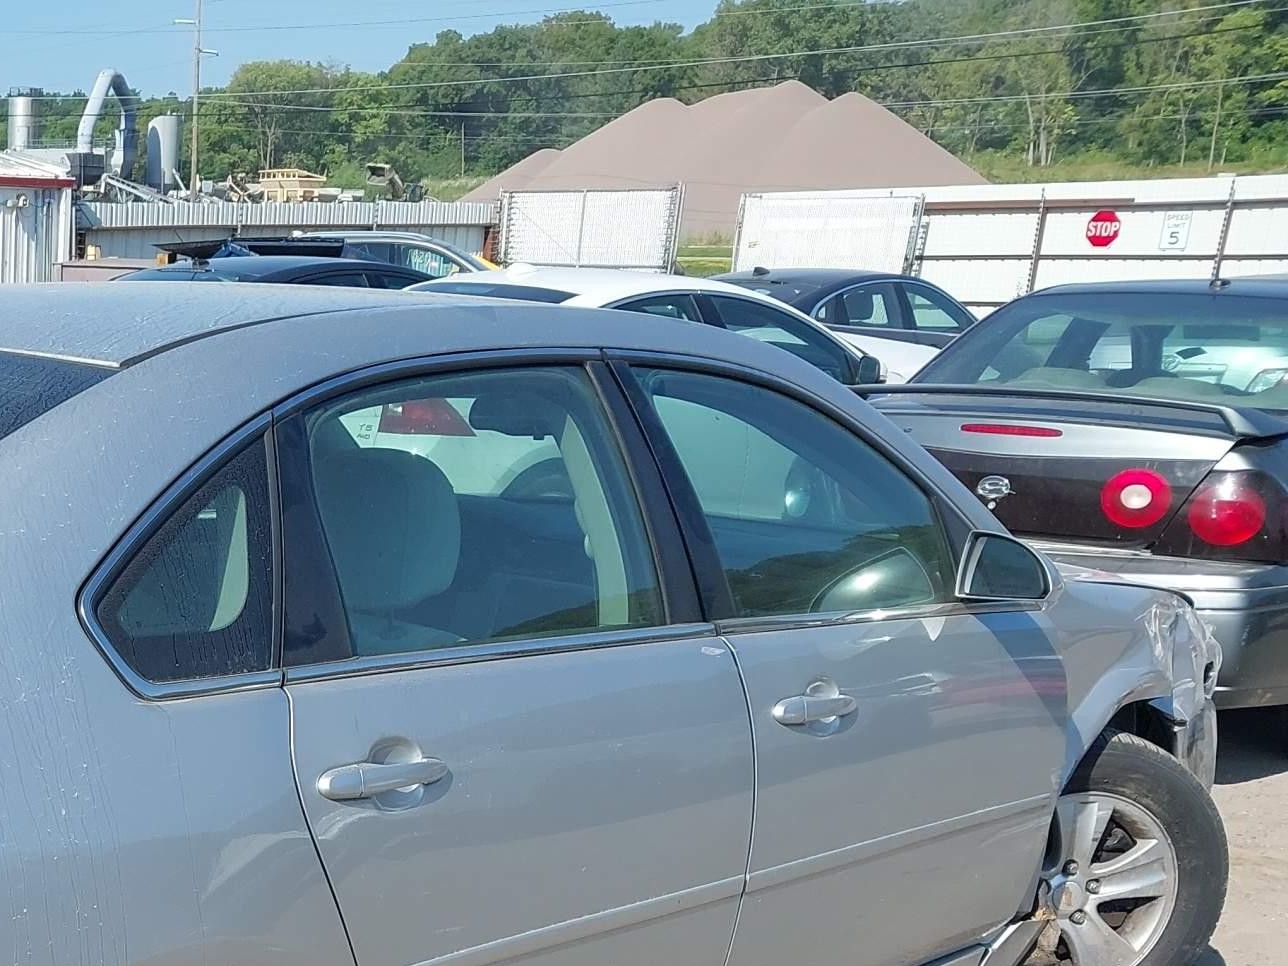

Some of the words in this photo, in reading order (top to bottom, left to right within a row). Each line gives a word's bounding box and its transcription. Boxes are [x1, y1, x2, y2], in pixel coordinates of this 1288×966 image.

[1167, 213, 1190, 221] SPEED
[1087, 221, 1120, 237] STOP
[1168, 231, 1179, 245] 5
